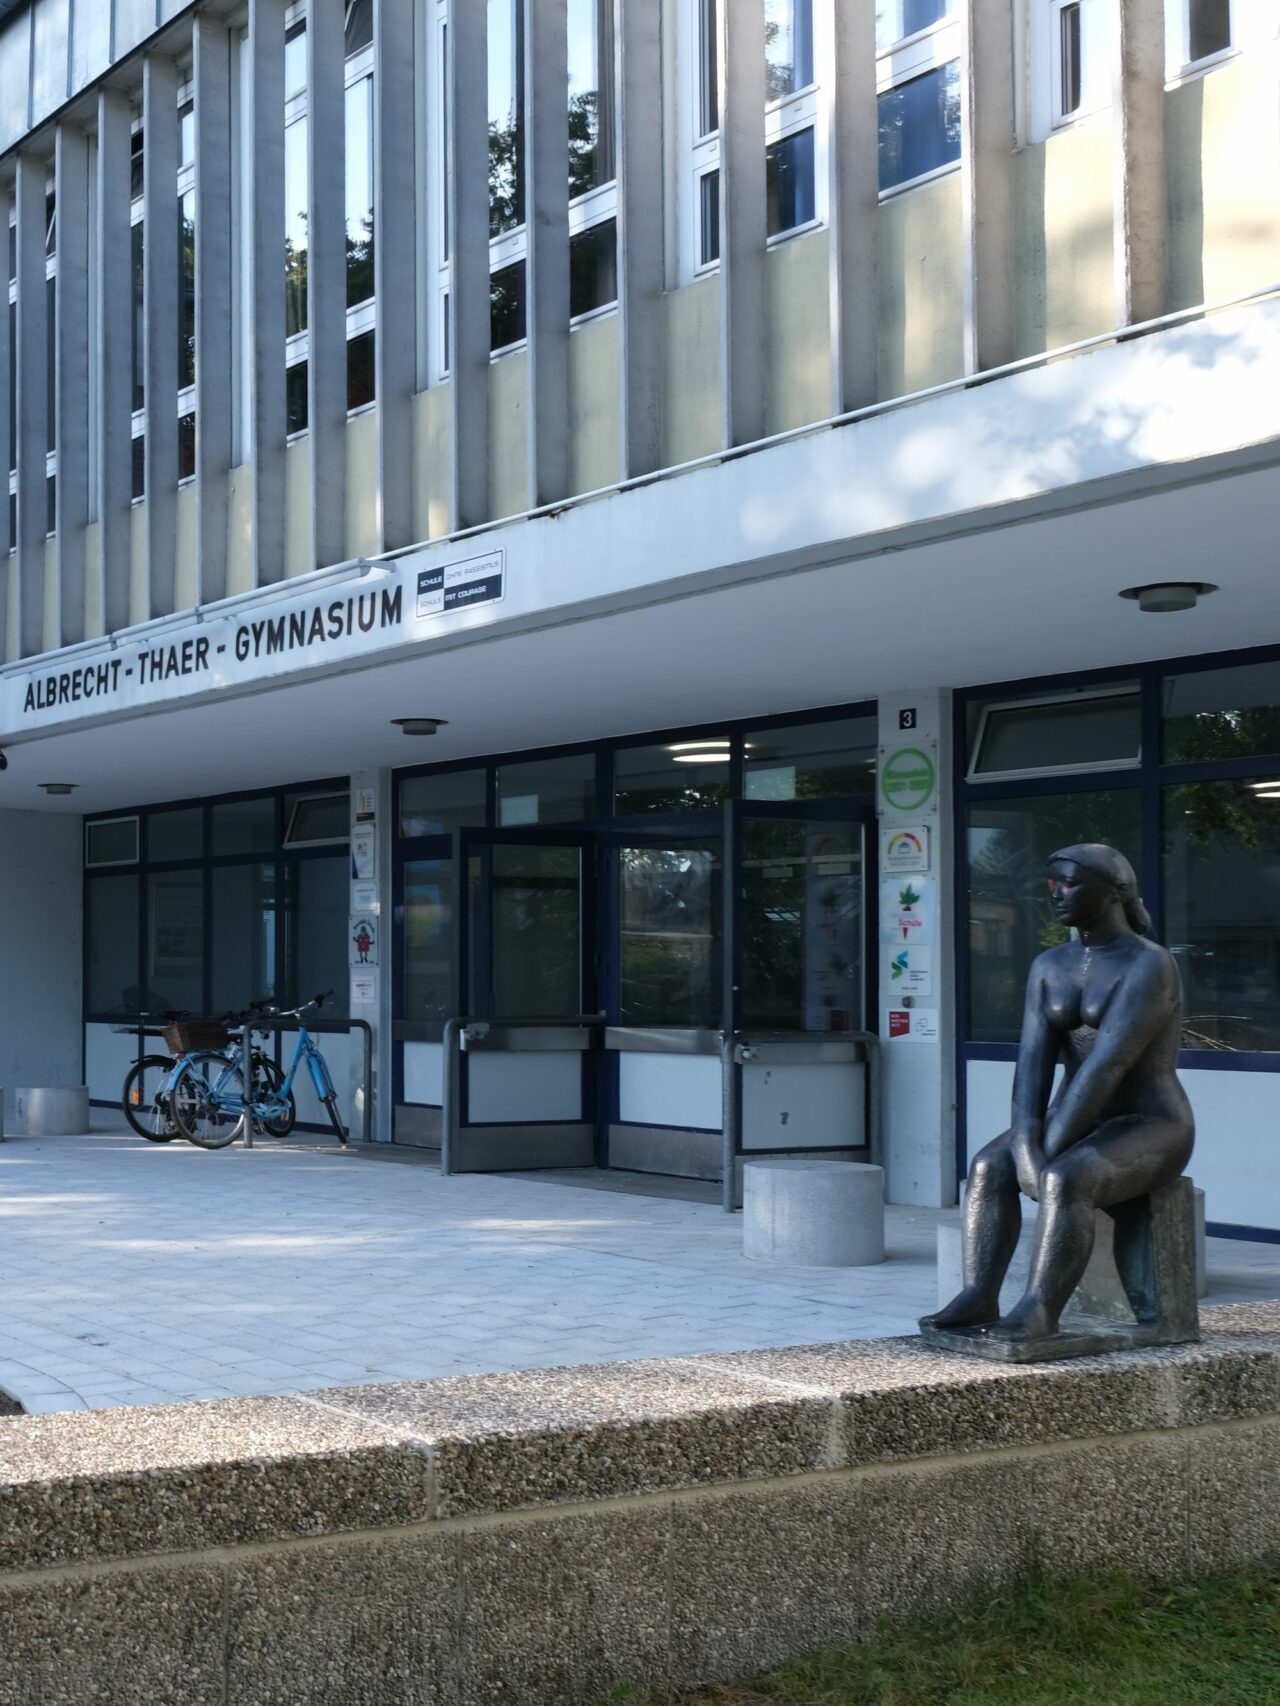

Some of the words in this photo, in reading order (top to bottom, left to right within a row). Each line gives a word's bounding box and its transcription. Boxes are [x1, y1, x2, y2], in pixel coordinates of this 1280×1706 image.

[420, 575, 442, 588] SCHULE
[445, 593, 456, 602] MIT
[457, 585, 487, 598] COURAGE
[902, 711, 913, 727] 3
